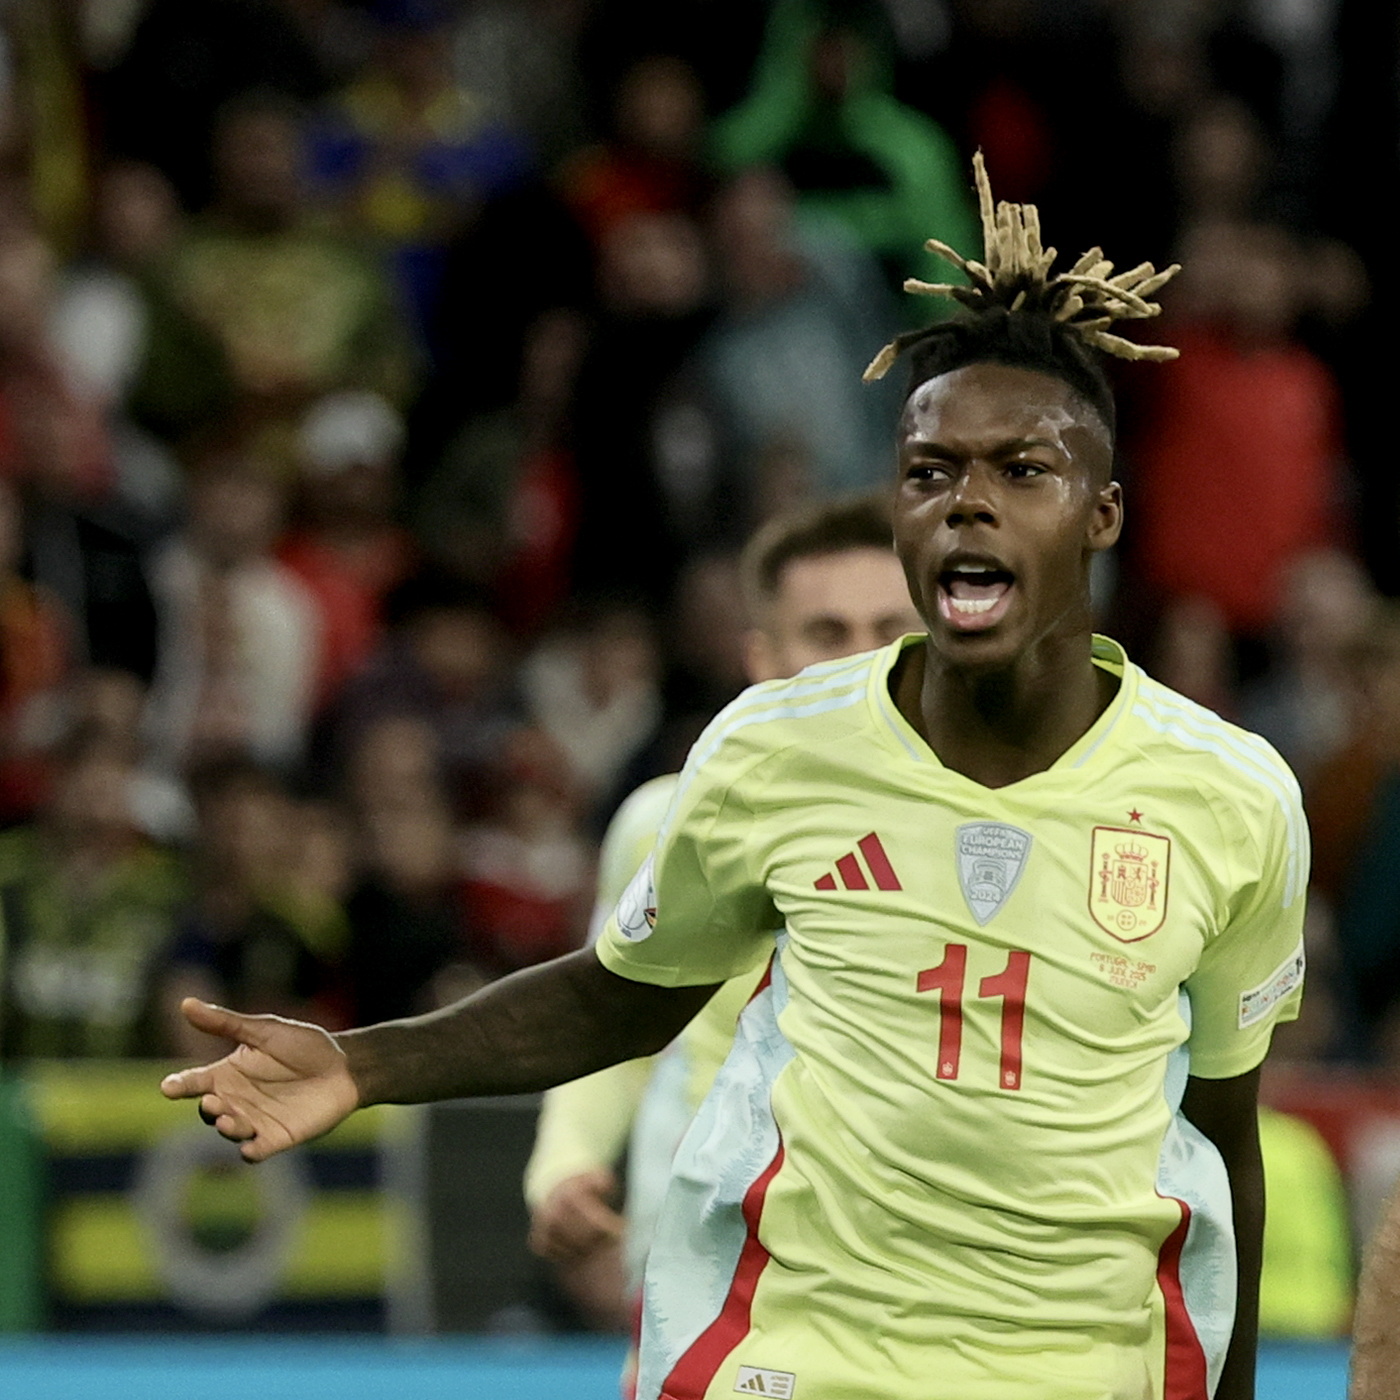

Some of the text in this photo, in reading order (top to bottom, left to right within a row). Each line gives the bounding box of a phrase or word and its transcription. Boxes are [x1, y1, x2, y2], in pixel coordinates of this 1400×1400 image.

[961, 834, 1024, 850] EUROPEAN
[960, 845, 1023, 860] CHAMPIONS
[916, 943, 1031, 1091] 11
